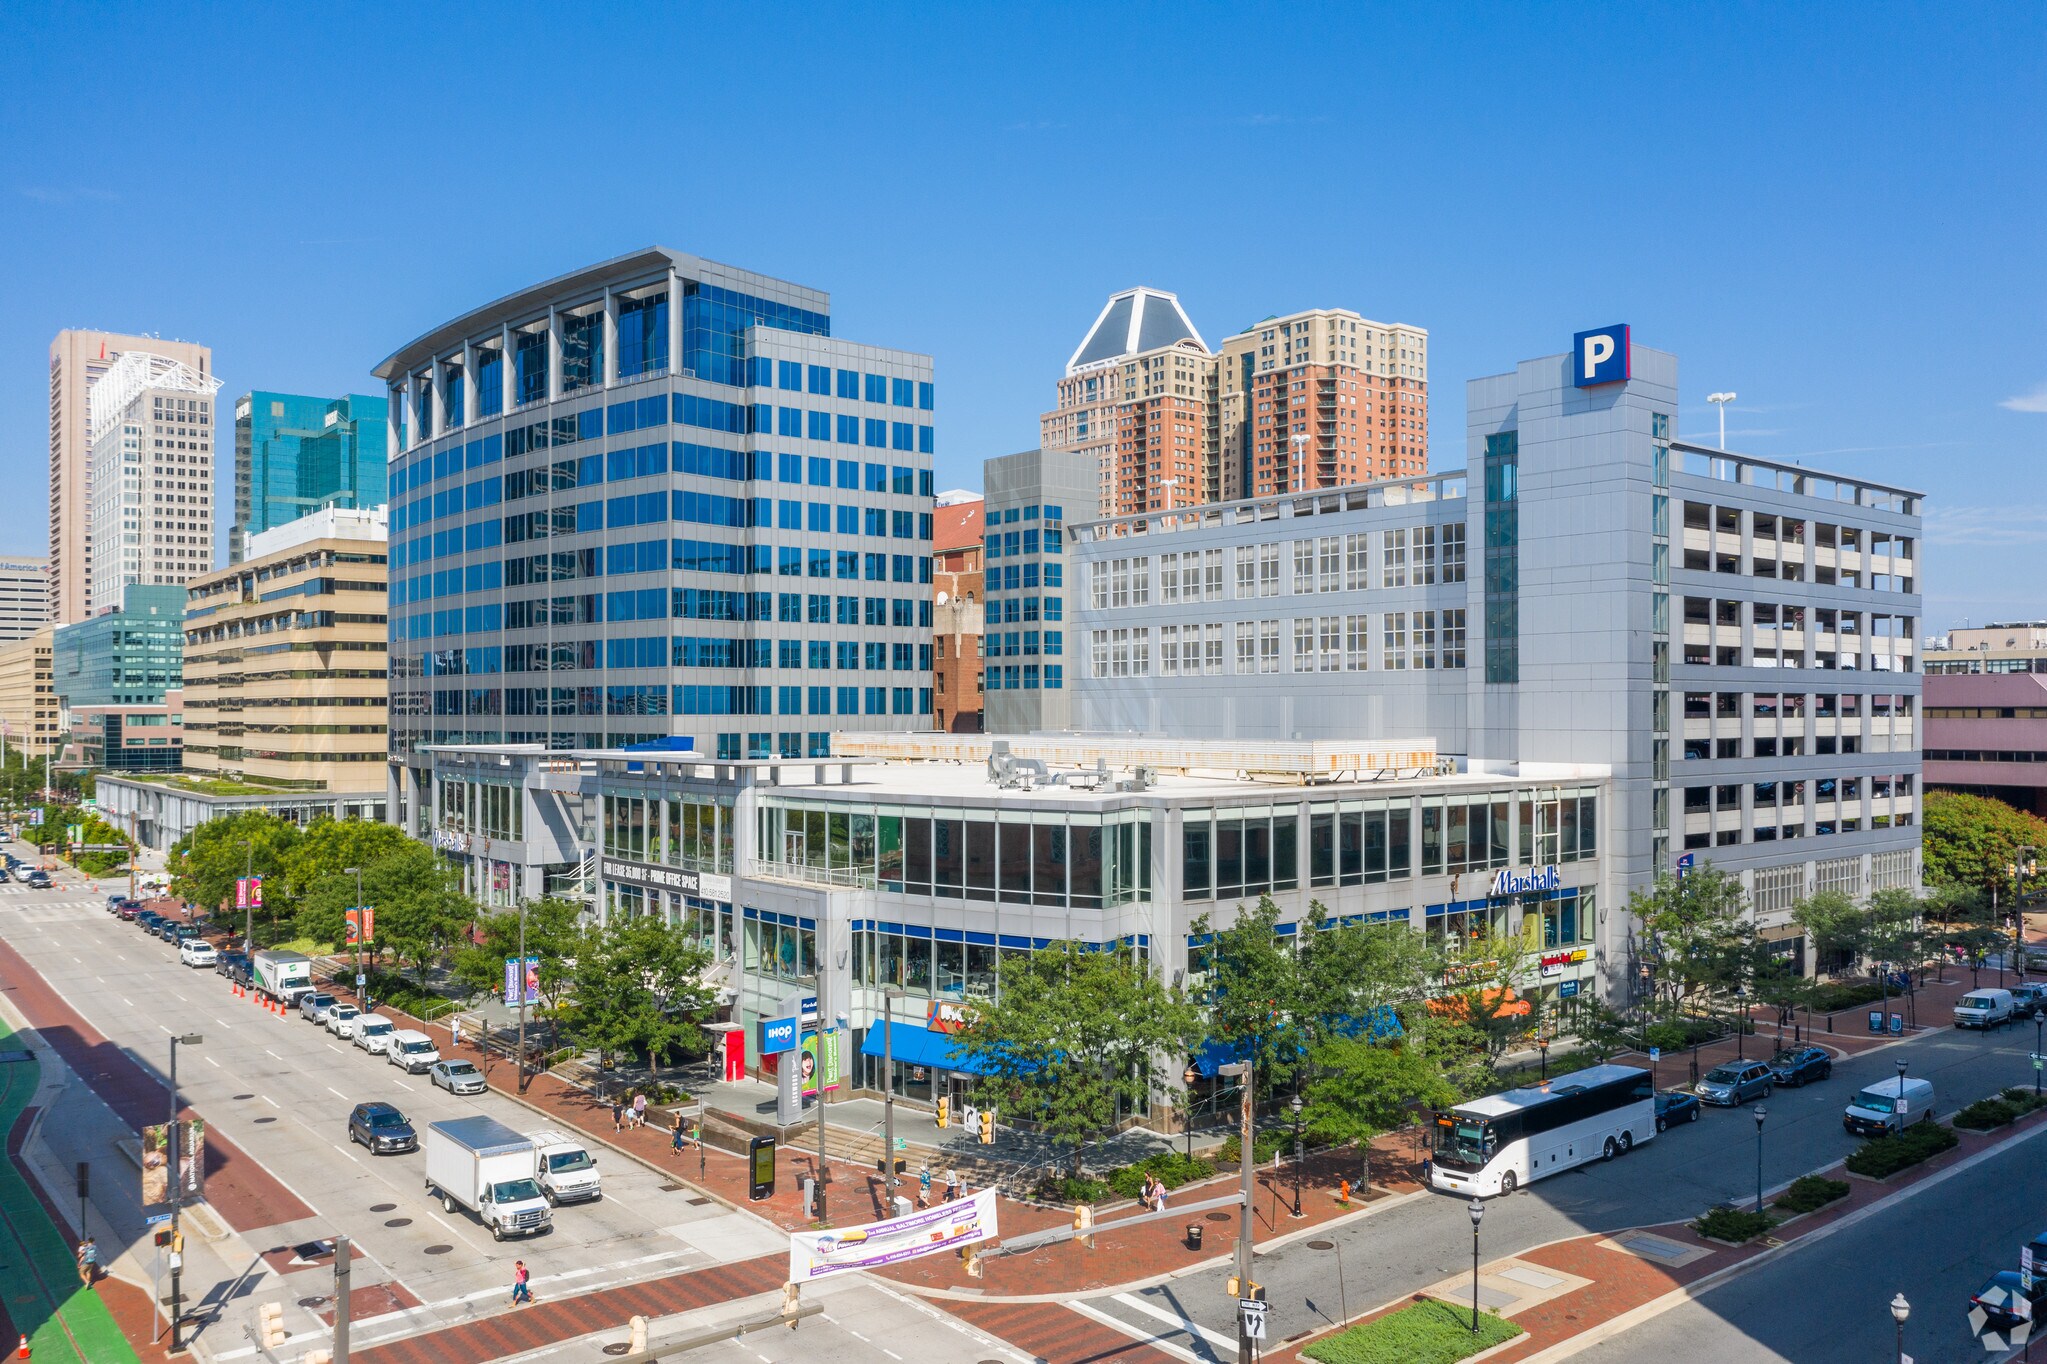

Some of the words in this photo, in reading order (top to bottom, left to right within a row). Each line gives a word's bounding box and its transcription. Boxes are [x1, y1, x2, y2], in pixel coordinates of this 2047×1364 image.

[1584, 334, 1615, 379] P
[603, 861, 612, 875] FOR
[612, 863, 626, 877] LEASE
[625, 866, 641, 880] 35,000
[641, 868, 648, 881] SF
[650, 869, 666, 884] PRIME
[665, 871, 682, 887] OFFICE
[681, 874, 698, 890] SPACE
[1491, 865, 1561, 896] Marshalls
[768, 1025, 792, 1039] IHOP
[188, 1126, 196, 1155] AQUARIUM
[188, 1155, 196, 1184] NATIONAL
[875, 1225, 896, 1236] ANNUAL
[896, 1216, 926, 1232] BALTIMORE
[925, 1208, 954, 1224] HOMELESS
